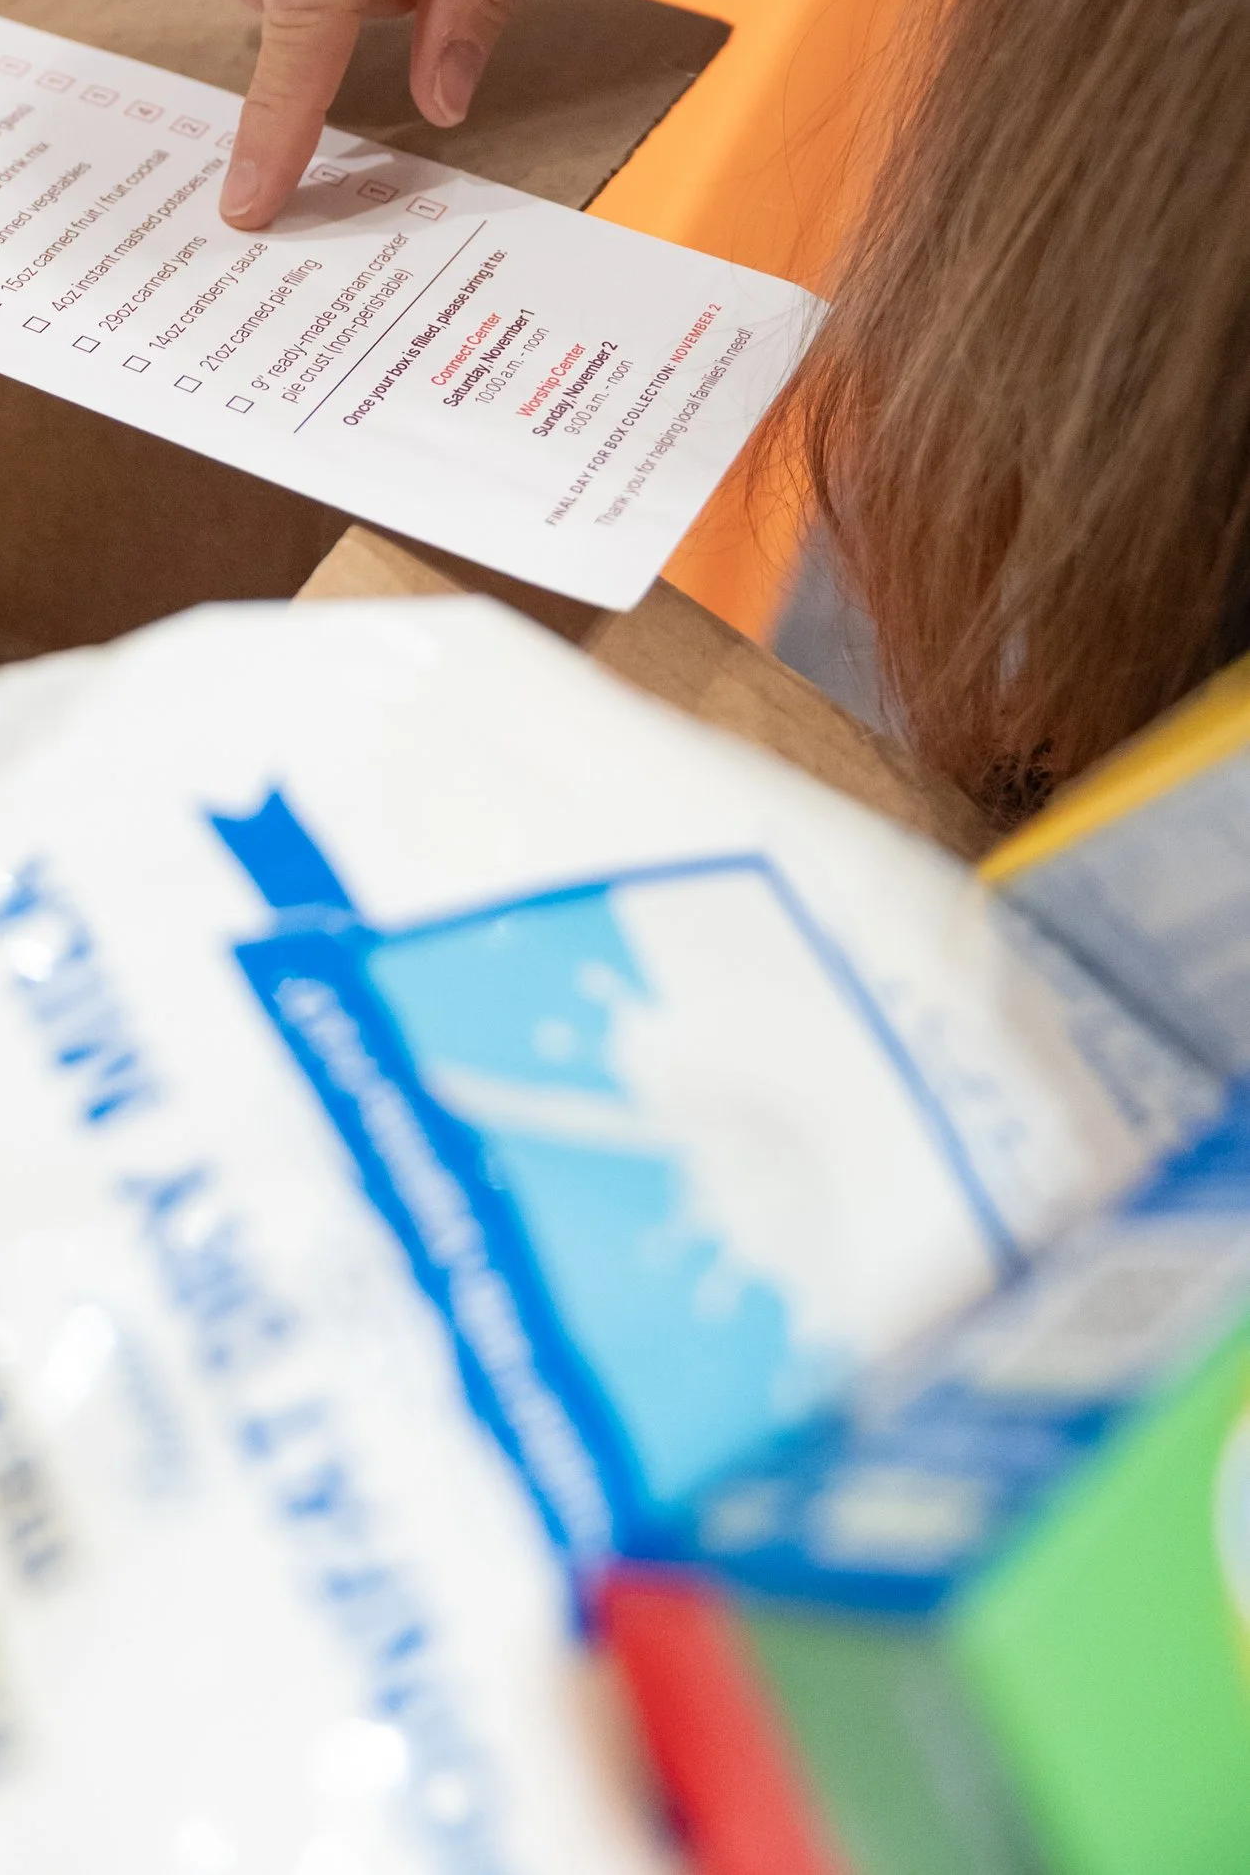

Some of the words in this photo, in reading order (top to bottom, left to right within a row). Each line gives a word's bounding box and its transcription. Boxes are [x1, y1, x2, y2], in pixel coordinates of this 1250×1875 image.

[23, 140, 51, 160] mix
[25, 161, 92, 212] vegetables
[0, 265, 39, 292] 15oz
[31, 226, 81, 268] canned
[68, 207, 104, 230] fruit
[97, 182, 132, 205] fruit
[124, 148, 170, 186] cocktail
[50, 288, 83, 312] 4oz
[69, 253, 121, 291] instant
[111, 212, 163, 257] mashed
[154, 174, 208, 218] potatoes
[199, 156, 225, 176] mix
[479, 261, 498, 271] it
[486, 248, 508, 263] to:
[97, 301, 139, 332] 29oz
[130, 260, 179, 303] canned
[169, 235, 208, 267] yams
[147, 322, 187, 350] 14oz
[178, 271, 239, 324] cranberry
[229, 241, 269, 274] sauce
[458, 267, 495, 295] bring
[197, 342, 238, 372] 21oz
[228, 300, 277, 344] canned
[267, 284, 293, 306] pie
[280, 257, 323, 287] filling
[266, 310, 338, 378] ready-made
[329, 270, 376, 313] graham
[366, 231, 409, 272] cracker
[434, 292, 470, 326] please
[279, 381, 307, 404] pie
[298, 351, 335, 383] crust
[321, 267, 414, 355] (non-perishable)
[401, 347, 422, 359] is
[409, 322, 447, 349] filled,
[429, 343, 476, 386] Connect
[464, 311, 502, 346] Center
[724, 326, 754, 357] need!
[384, 355, 414, 377] box
[441, 362, 494, 407] Saturday,
[478, 313, 530, 364] November
[519, 308, 535, 316] 1
[473, 376, 507, 404] 10:00
[499, 358, 525, 379] a.m.
[521, 326, 550, 353] noon
[714, 355, 735, 367] in
[367, 374, 396, 401] your
[514, 375, 562, 417] Worship
[549, 341, 586, 377] Center
[530, 397, 578, 437] Sunday,
[561, 347, 612, 399] November
[601, 341, 619, 351] 2
[562, 409, 593, 435] 9:00
[583, 392, 610, 413] a.m.
[605, 358, 634, 385] noon
[688, 364, 728, 401] families
[341, 397, 376, 426] Once
[543, 495, 578, 526] FINAL
[568, 470, 594, 495] DAY
[585, 448, 612, 472] FOR
[602, 425, 629, 450] BOX
[620, 362, 677, 427] COLLECTION:
[668, 310, 717, 364] NOVEMBER
[708, 303, 722, 312] 2
[671, 397, 702, 424] local
[645, 421, 689, 460] helping
[622, 472, 647, 497] you
[632, 457, 657, 475] for
[593, 493, 632, 526] Thank
